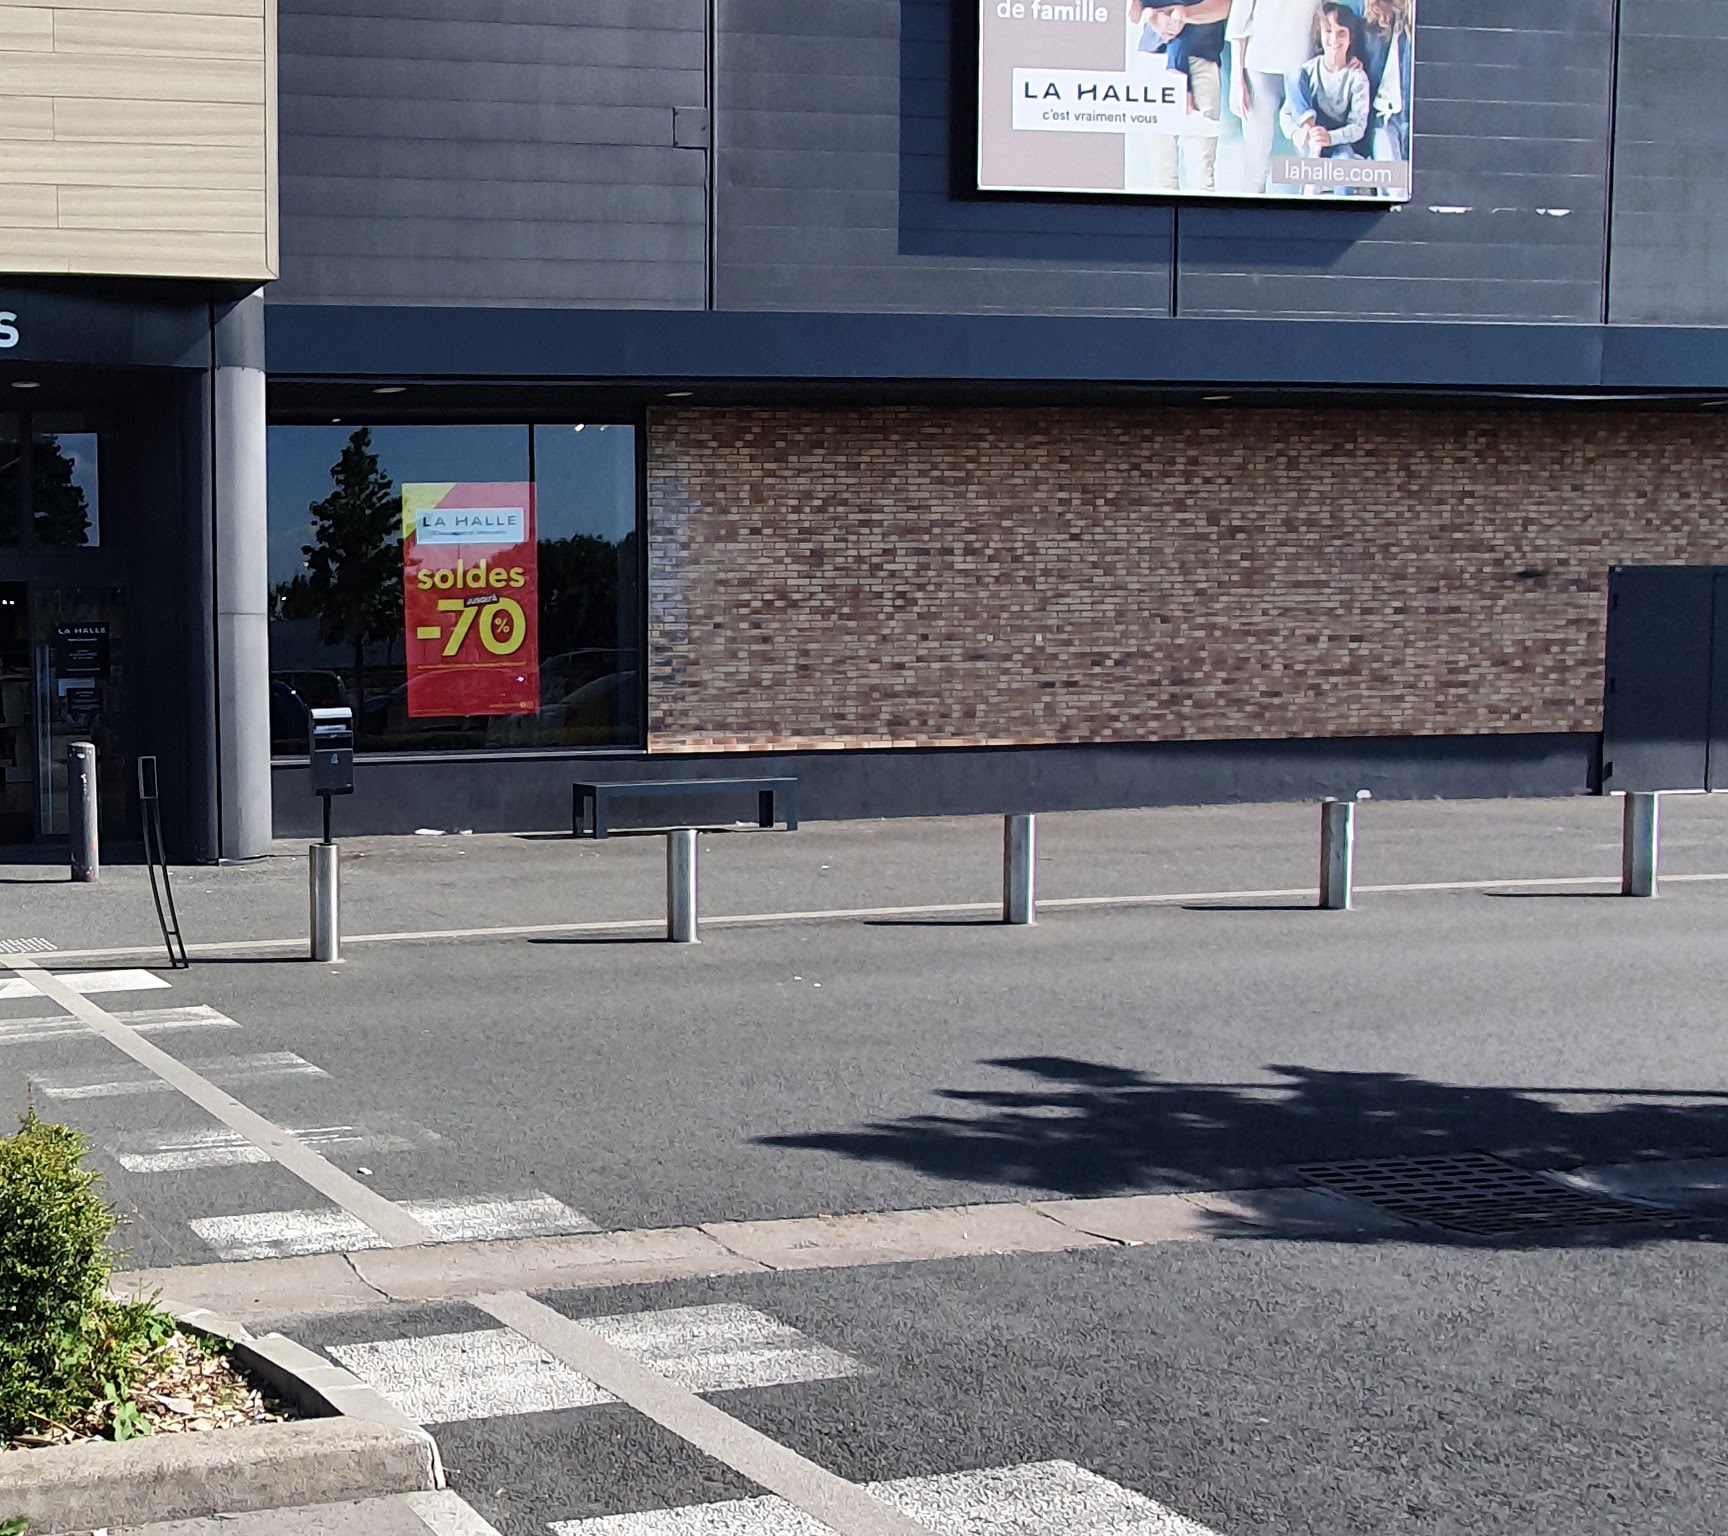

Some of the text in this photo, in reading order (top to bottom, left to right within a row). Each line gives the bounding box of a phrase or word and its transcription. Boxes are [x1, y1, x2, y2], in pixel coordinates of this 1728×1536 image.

[1024, 81, 1176, 104] LA HALLE
[1042, 109, 1158, 124] c'est vraiment vous
[1284, 160, 1392, 183] lahalle.com
[422, 515, 517, 527] LA HALLE
[417, 558, 525, 590] soldes
